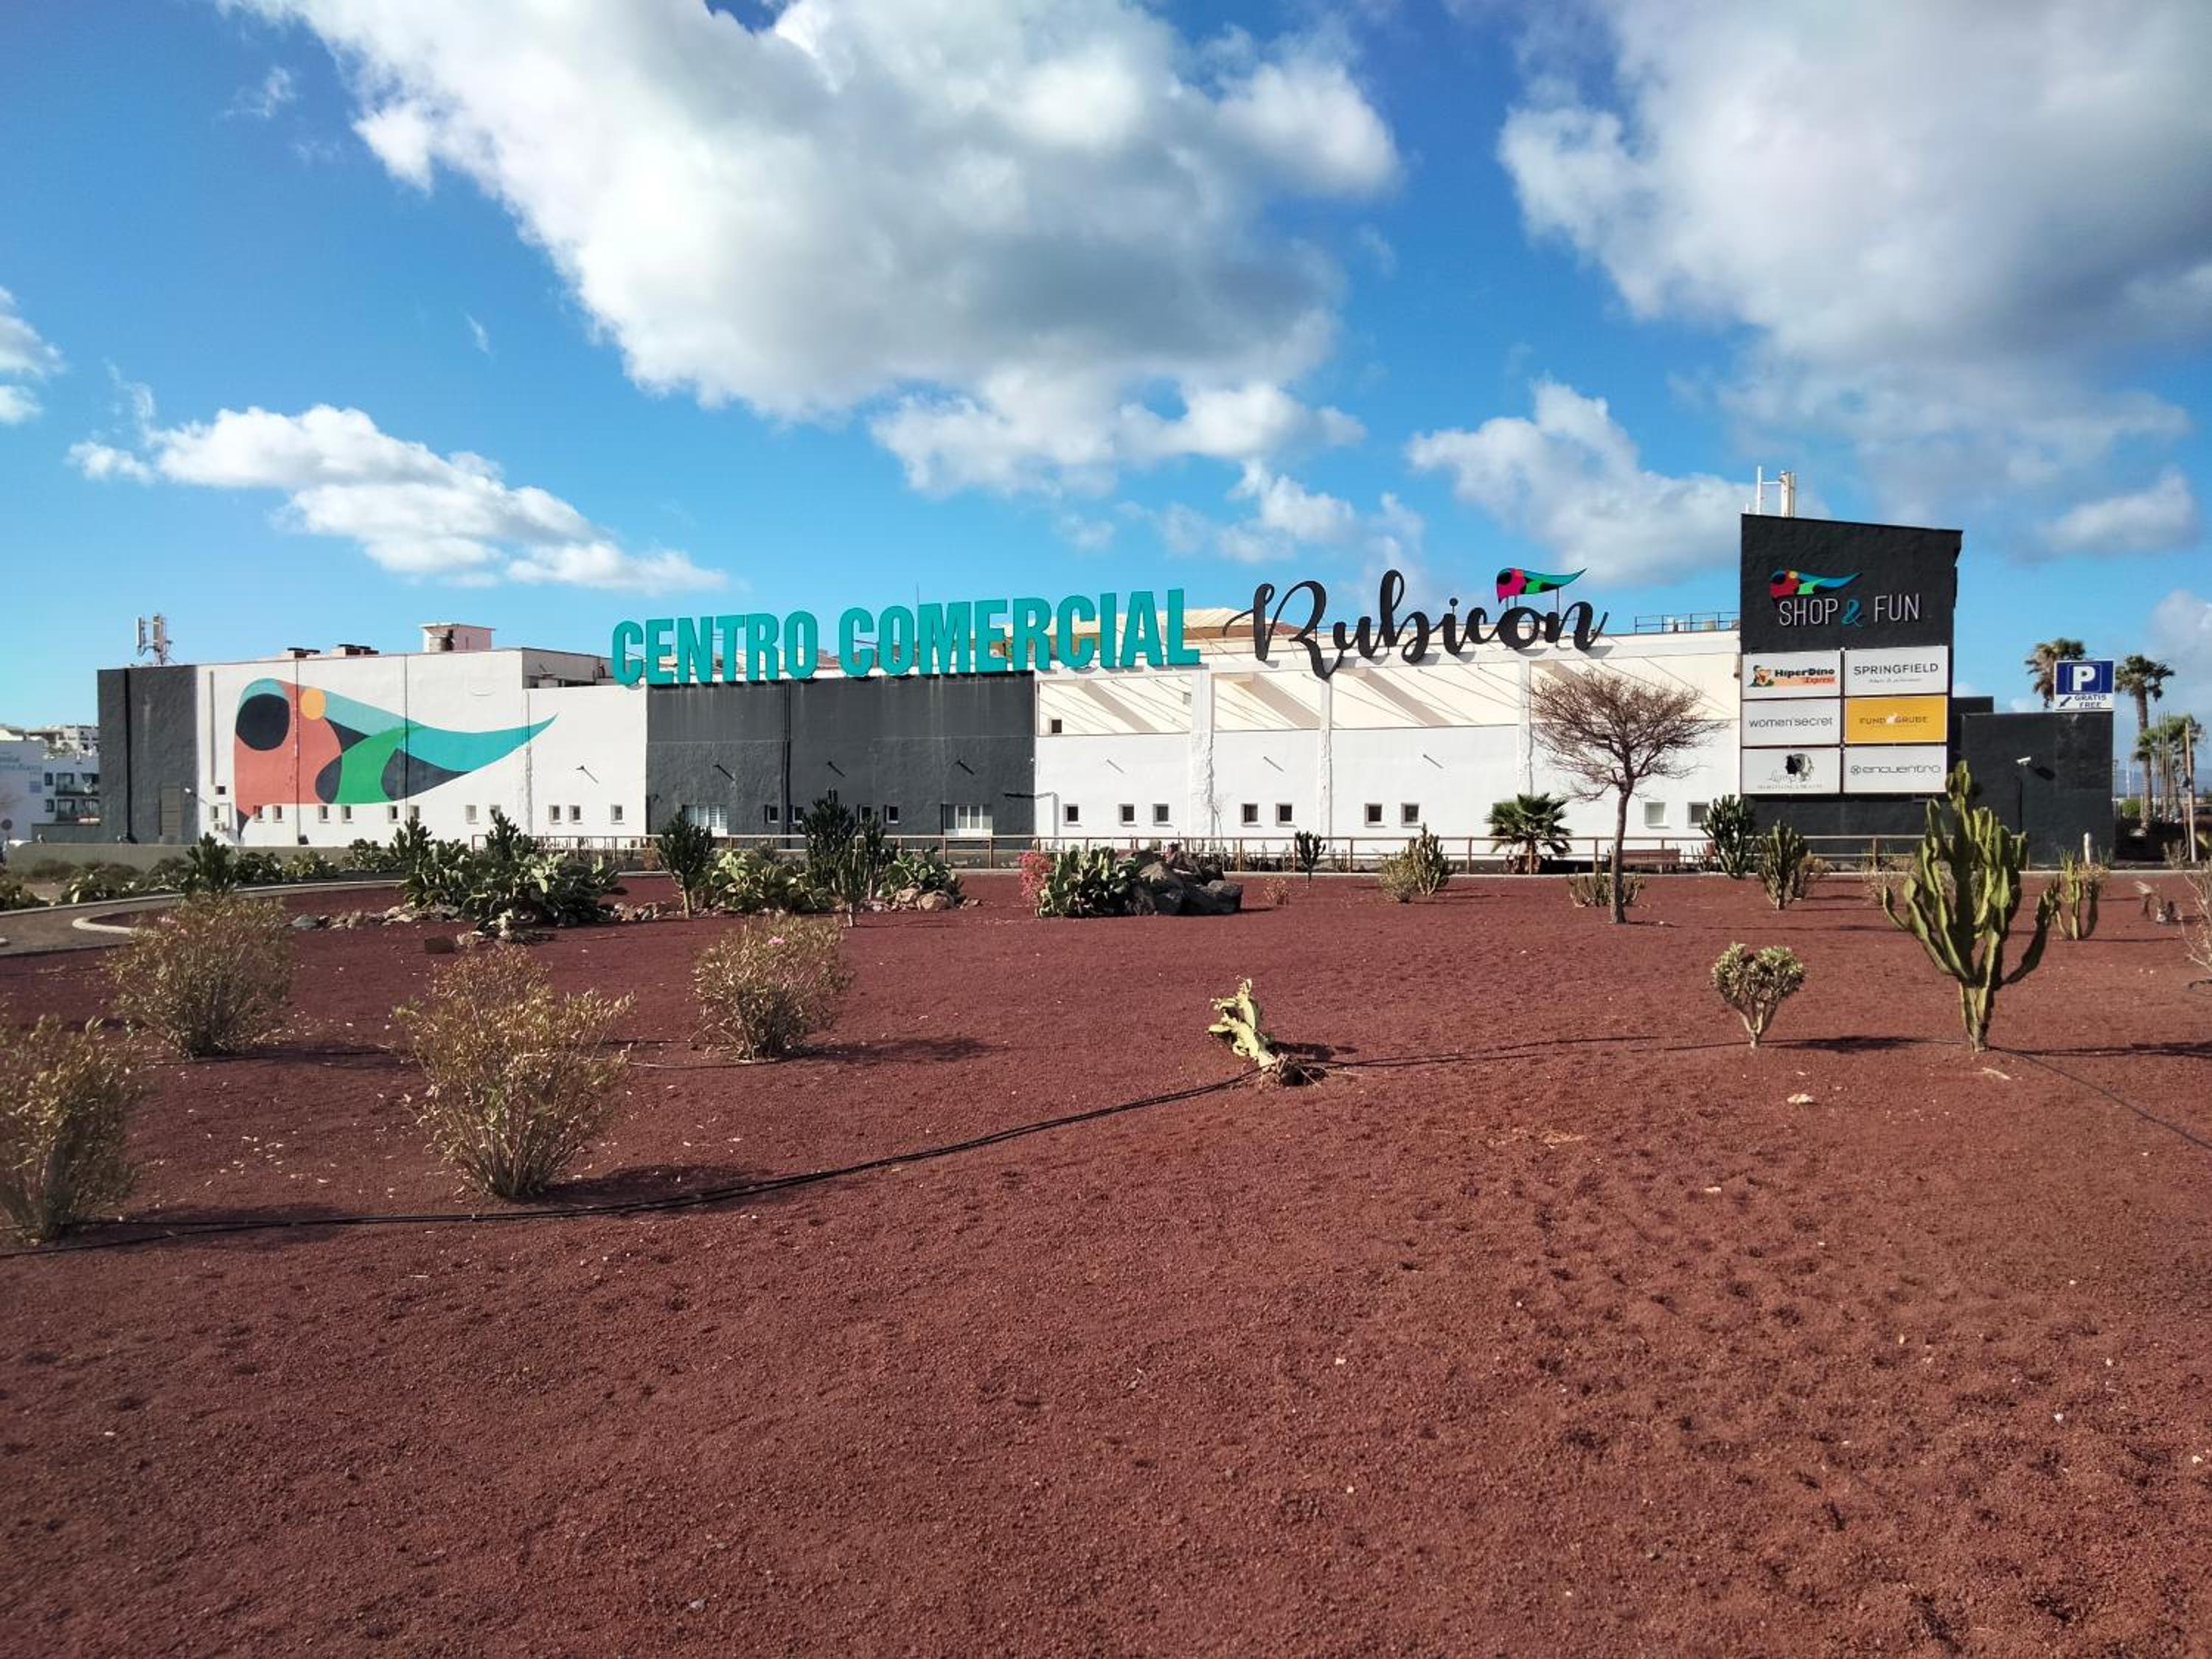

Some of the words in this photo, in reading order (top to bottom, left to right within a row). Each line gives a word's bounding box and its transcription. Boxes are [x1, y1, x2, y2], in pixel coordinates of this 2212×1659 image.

[1778, 598, 1839, 626] SHOP
[1842, 599, 1863, 627] &
[1874, 593, 1920, 622] FUN
[611, 611, 819, 687] CENTRO
[838, 588, 1201, 678] COMERCIAL
[1775, 667, 1836, 679] HiperDino
[1853, 663, 1939, 676] SPRINGFIELD
[2073, 666, 2096, 691] P
